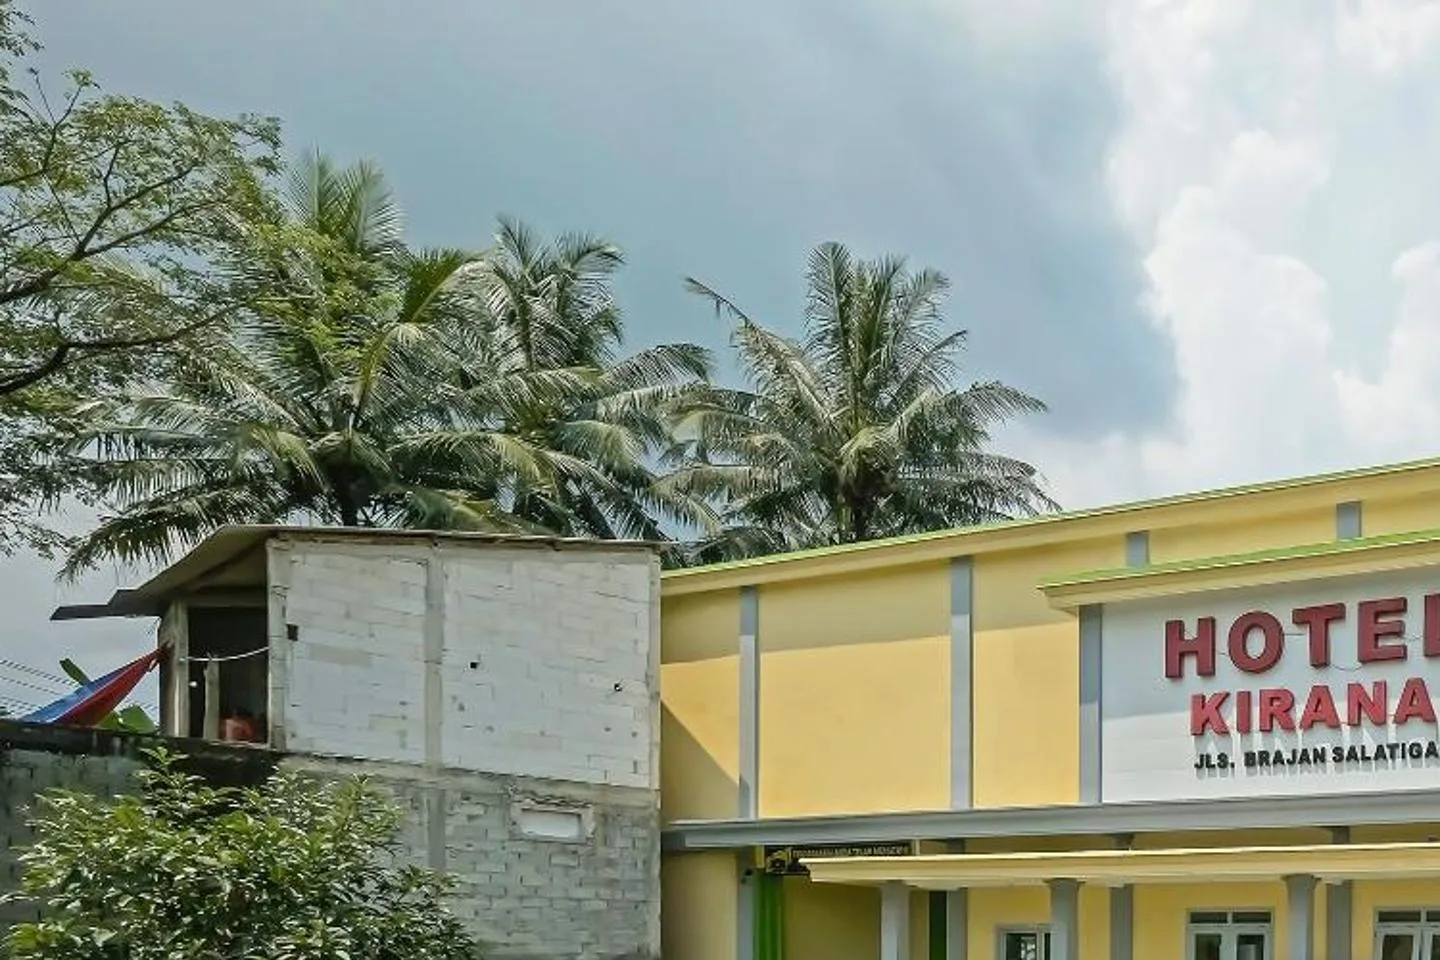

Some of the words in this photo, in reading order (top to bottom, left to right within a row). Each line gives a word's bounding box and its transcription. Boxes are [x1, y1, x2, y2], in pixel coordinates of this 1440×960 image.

[1191, 677, 1437, 736] KIRANA
[1193, 753, 1236, 770] JLS.
[1244, 747, 1326, 768] BRAJAN
[1332, 741, 1440, 762] SALATIGA
